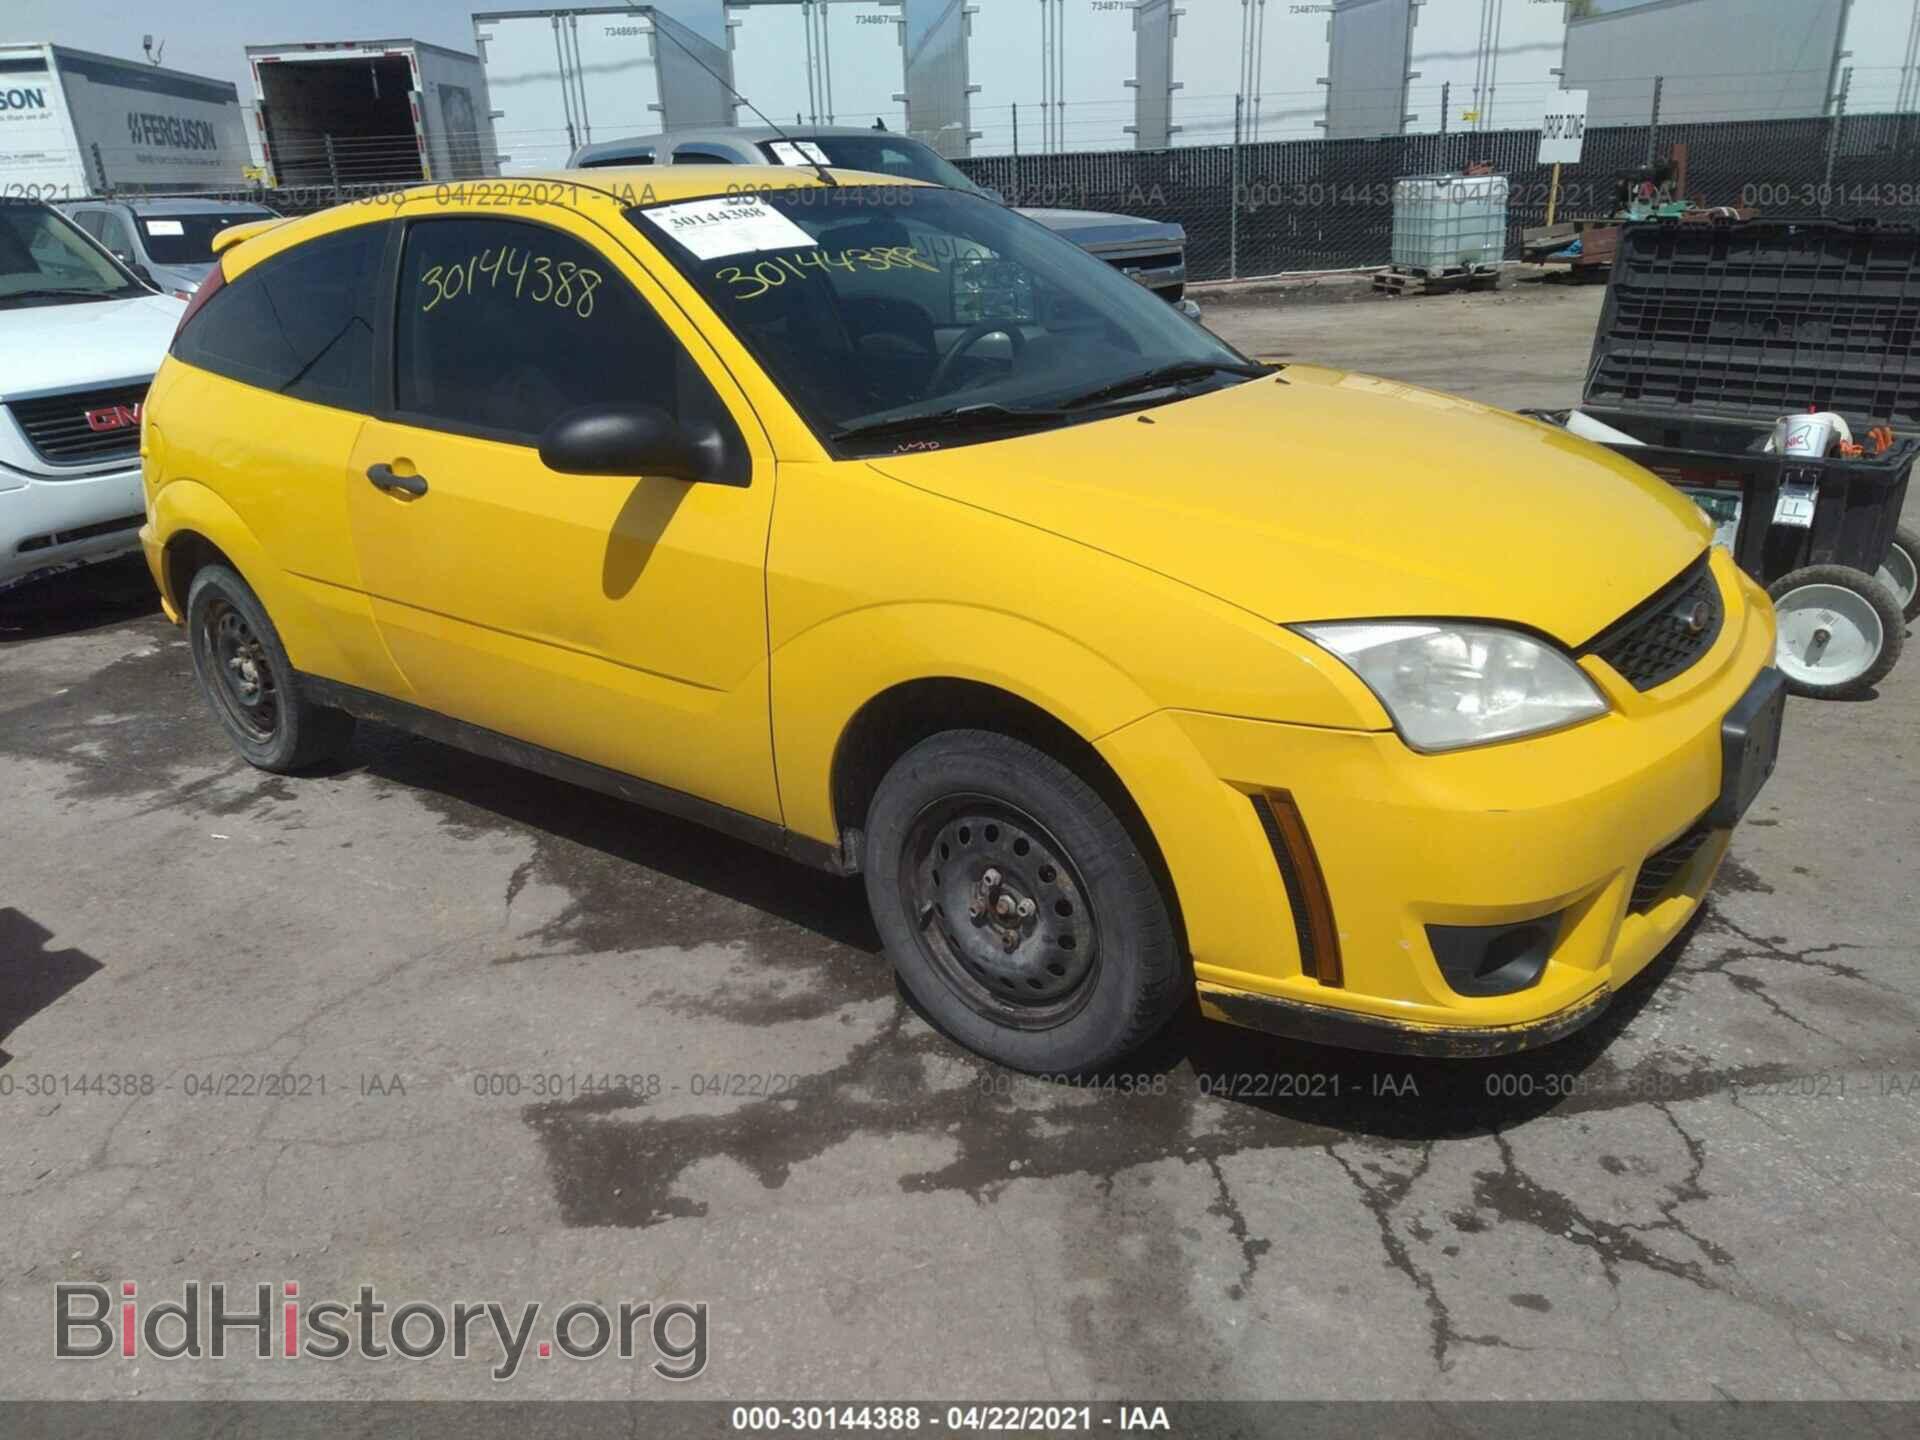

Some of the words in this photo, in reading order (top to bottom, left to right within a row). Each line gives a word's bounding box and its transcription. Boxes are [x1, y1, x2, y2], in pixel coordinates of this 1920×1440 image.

[139, 113, 218, 151] FERGUSON
[1543, 114, 1563, 140] DROP
[1564, 113, 1585, 140] ZONE
[669, 206, 768, 229] 30144388
[421, 245, 602, 318] 30144388
